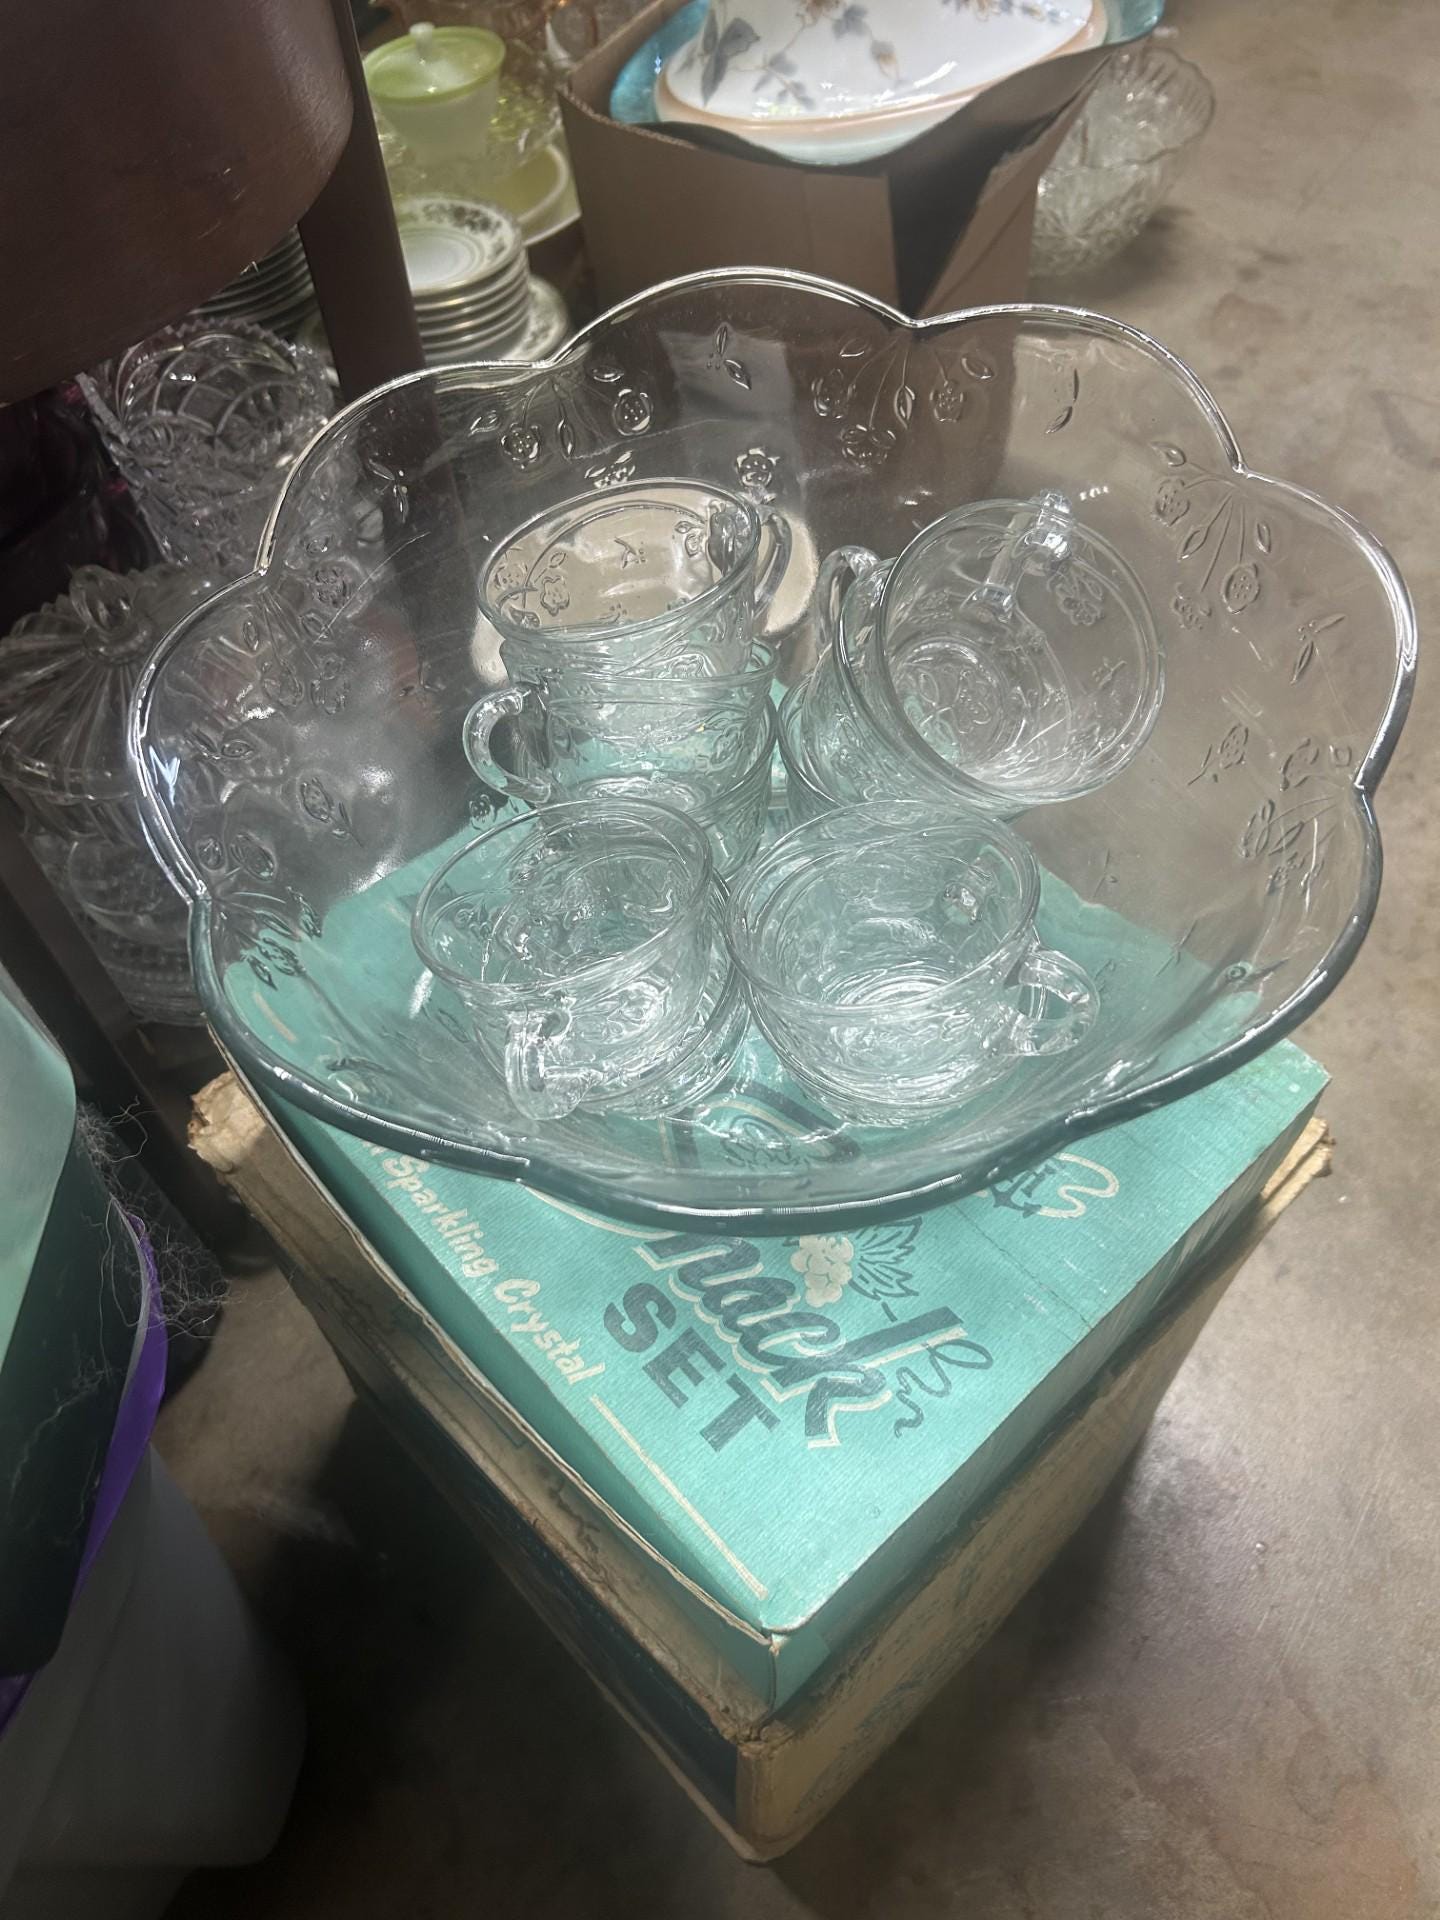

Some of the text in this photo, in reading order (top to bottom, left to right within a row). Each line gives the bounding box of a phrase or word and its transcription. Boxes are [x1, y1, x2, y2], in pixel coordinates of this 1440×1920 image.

[382, 1157, 606, 1386] Sparkling Crystal
[603, 1282, 781, 1453] SET
